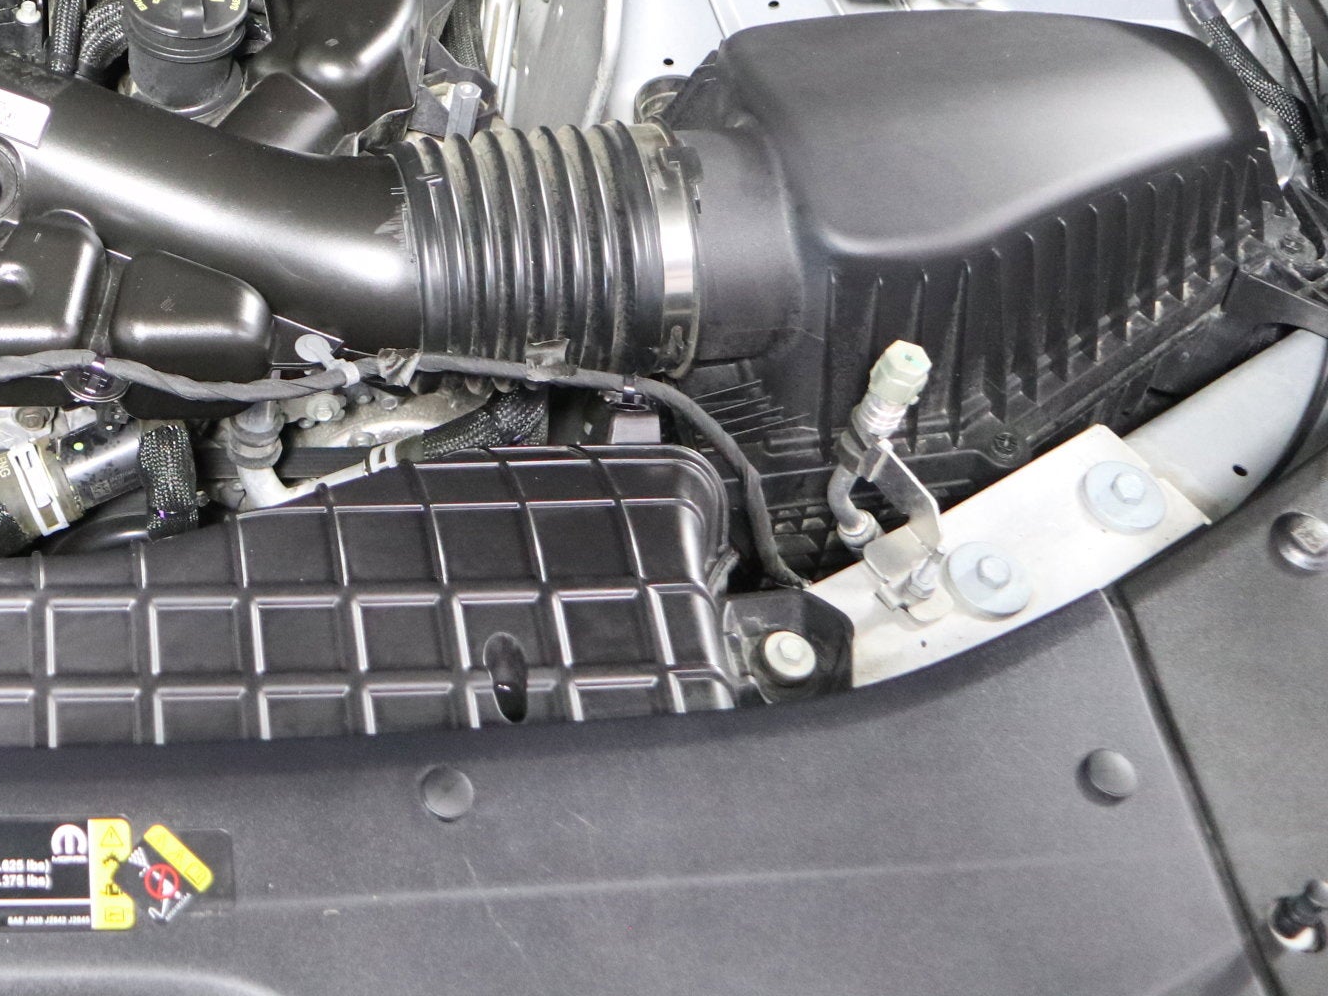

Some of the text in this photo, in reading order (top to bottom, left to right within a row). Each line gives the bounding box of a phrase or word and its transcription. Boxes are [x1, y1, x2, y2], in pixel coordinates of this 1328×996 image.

[26, 859, 52, 874] lbs)
[26, 874, 52, 889] lbs)
[7, 915, 24, 925] SAE
